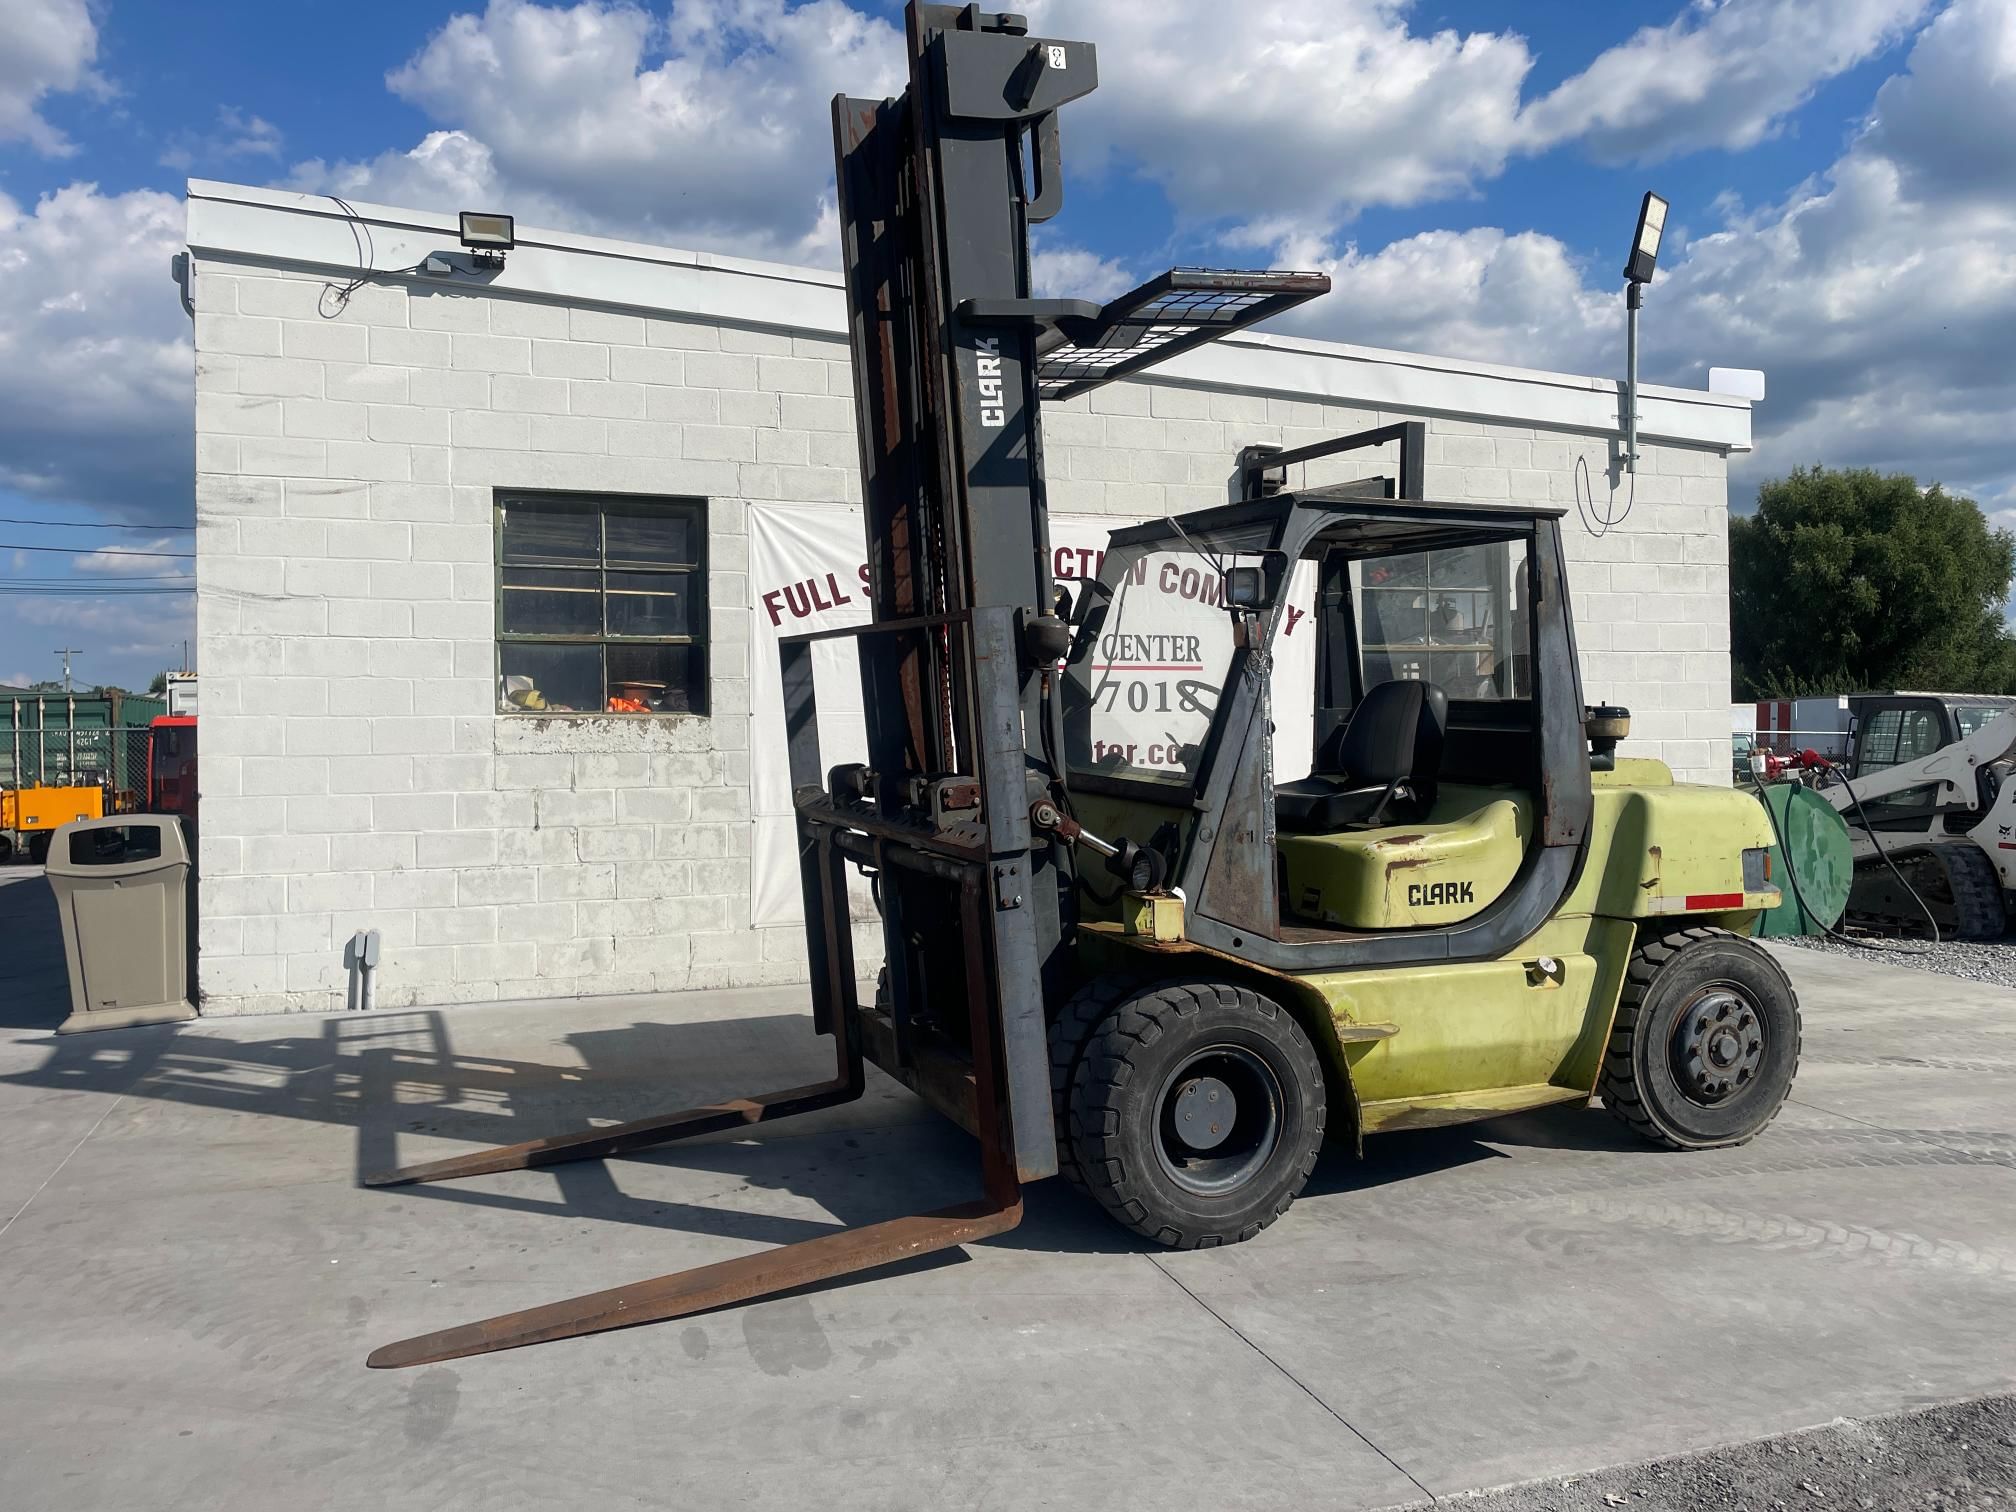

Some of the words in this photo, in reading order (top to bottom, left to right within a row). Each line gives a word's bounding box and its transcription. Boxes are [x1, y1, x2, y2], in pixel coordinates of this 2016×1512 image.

[975, 338, 1005, 427] CLARK
[762, 573, 852, 627] FULL
[1101, 633, 1202, 663] CENTER
[1409, 881, 1473, 906] CLARK
